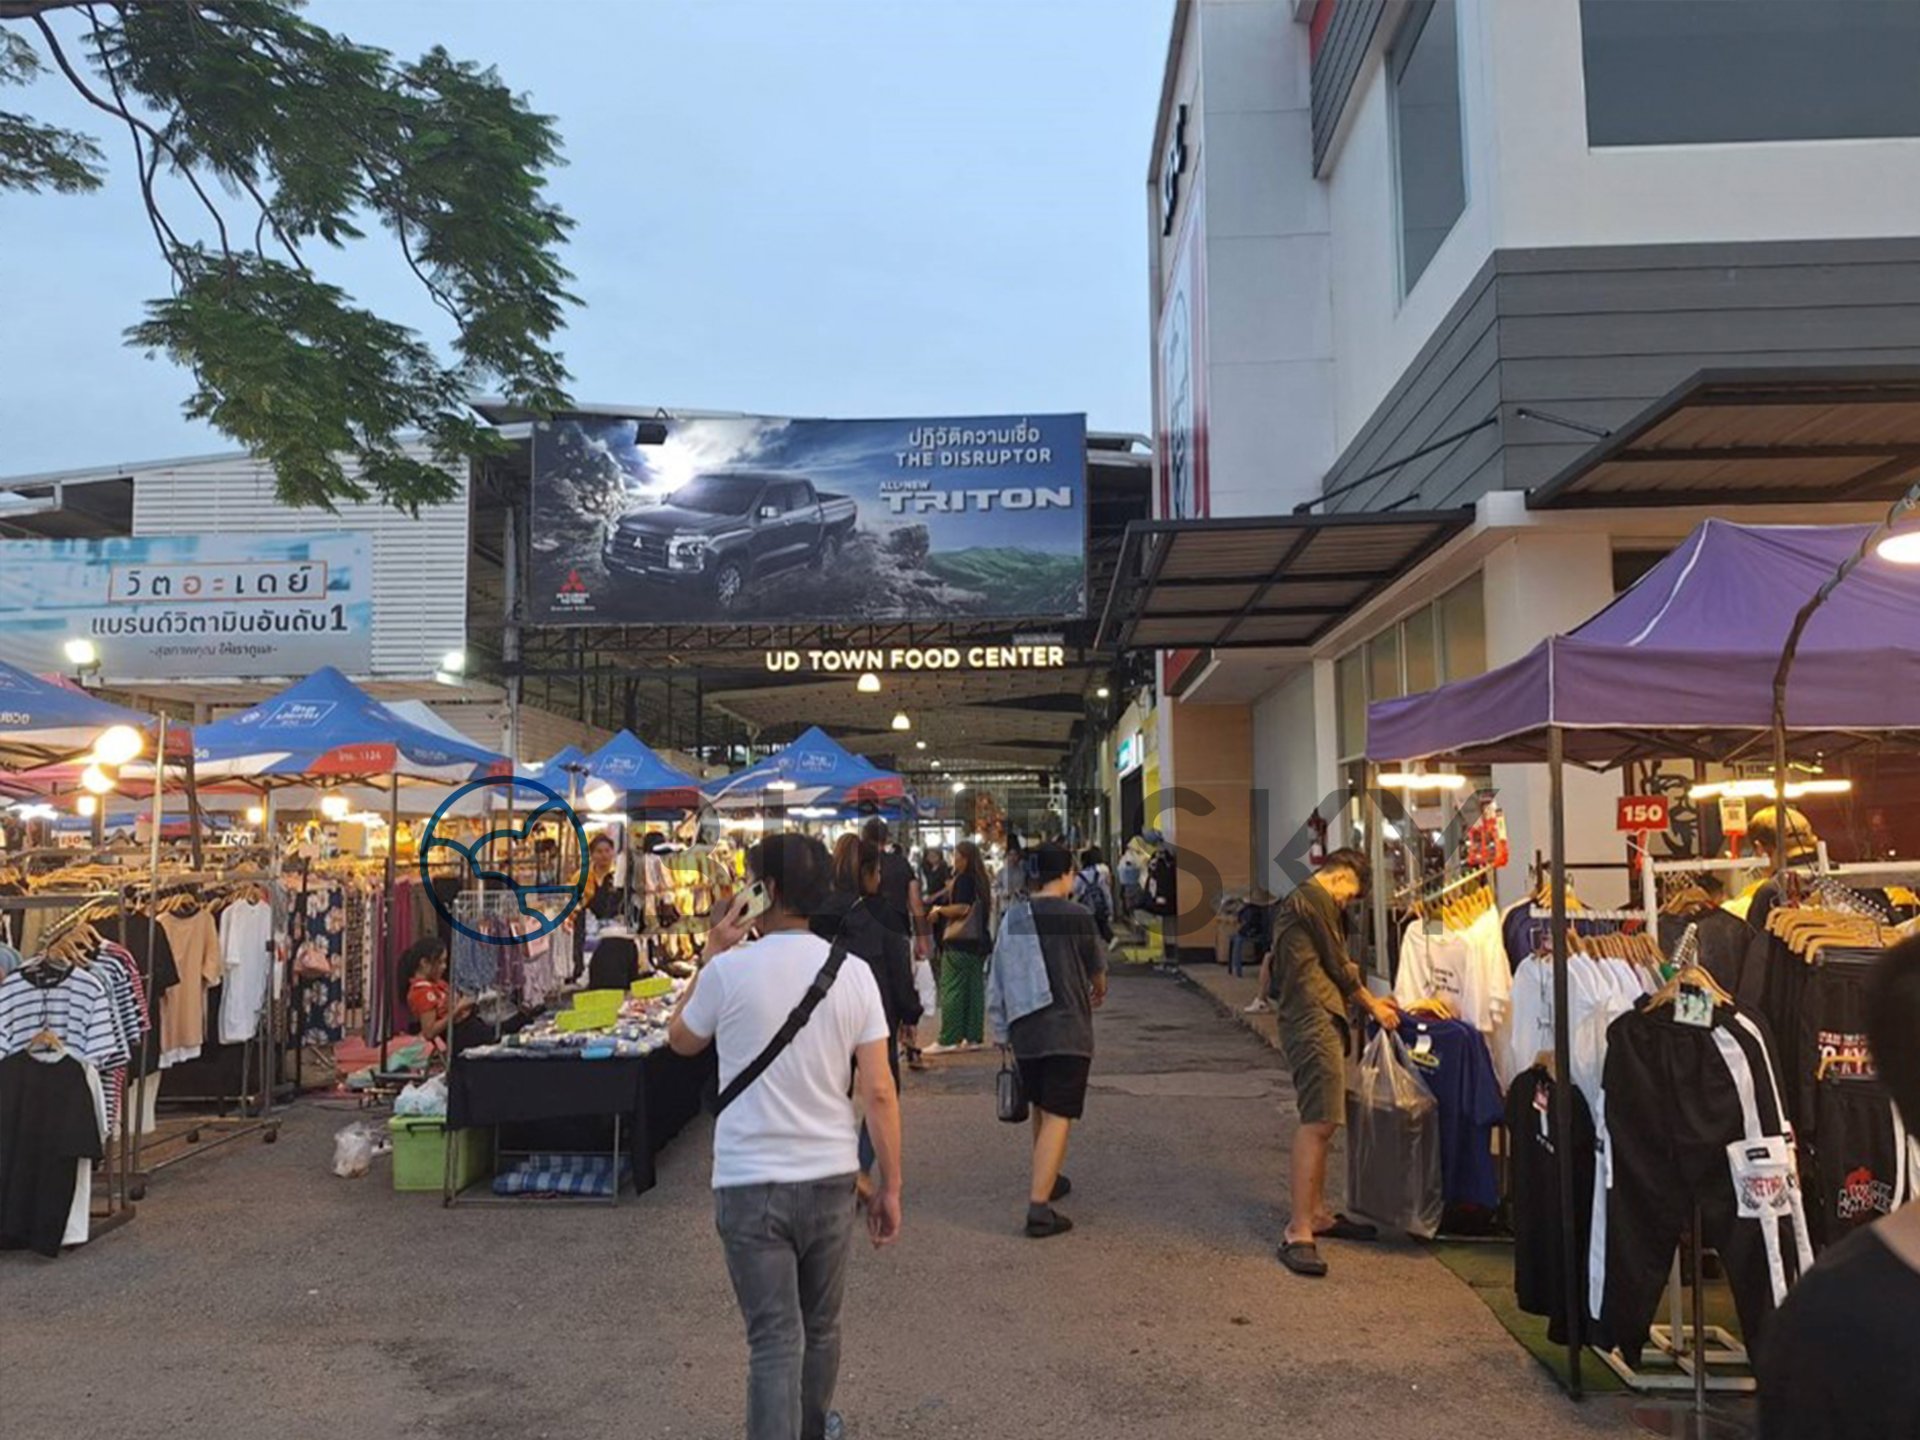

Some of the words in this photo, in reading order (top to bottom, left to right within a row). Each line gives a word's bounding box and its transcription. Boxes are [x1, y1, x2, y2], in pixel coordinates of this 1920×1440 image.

[897, 452, 933, 466] THE
[941, 448, 1051, 466] DISRUPTOR
[880, 487, 1071, 513] TRITON
[766, 653, 800, 670] UD
[808, 651, 883, 670] TOWN
[890, 649, 960, 669] FOOD
[968, 646, 1064, 667] CENTER
[1624, 804, 1663, 822] 150
